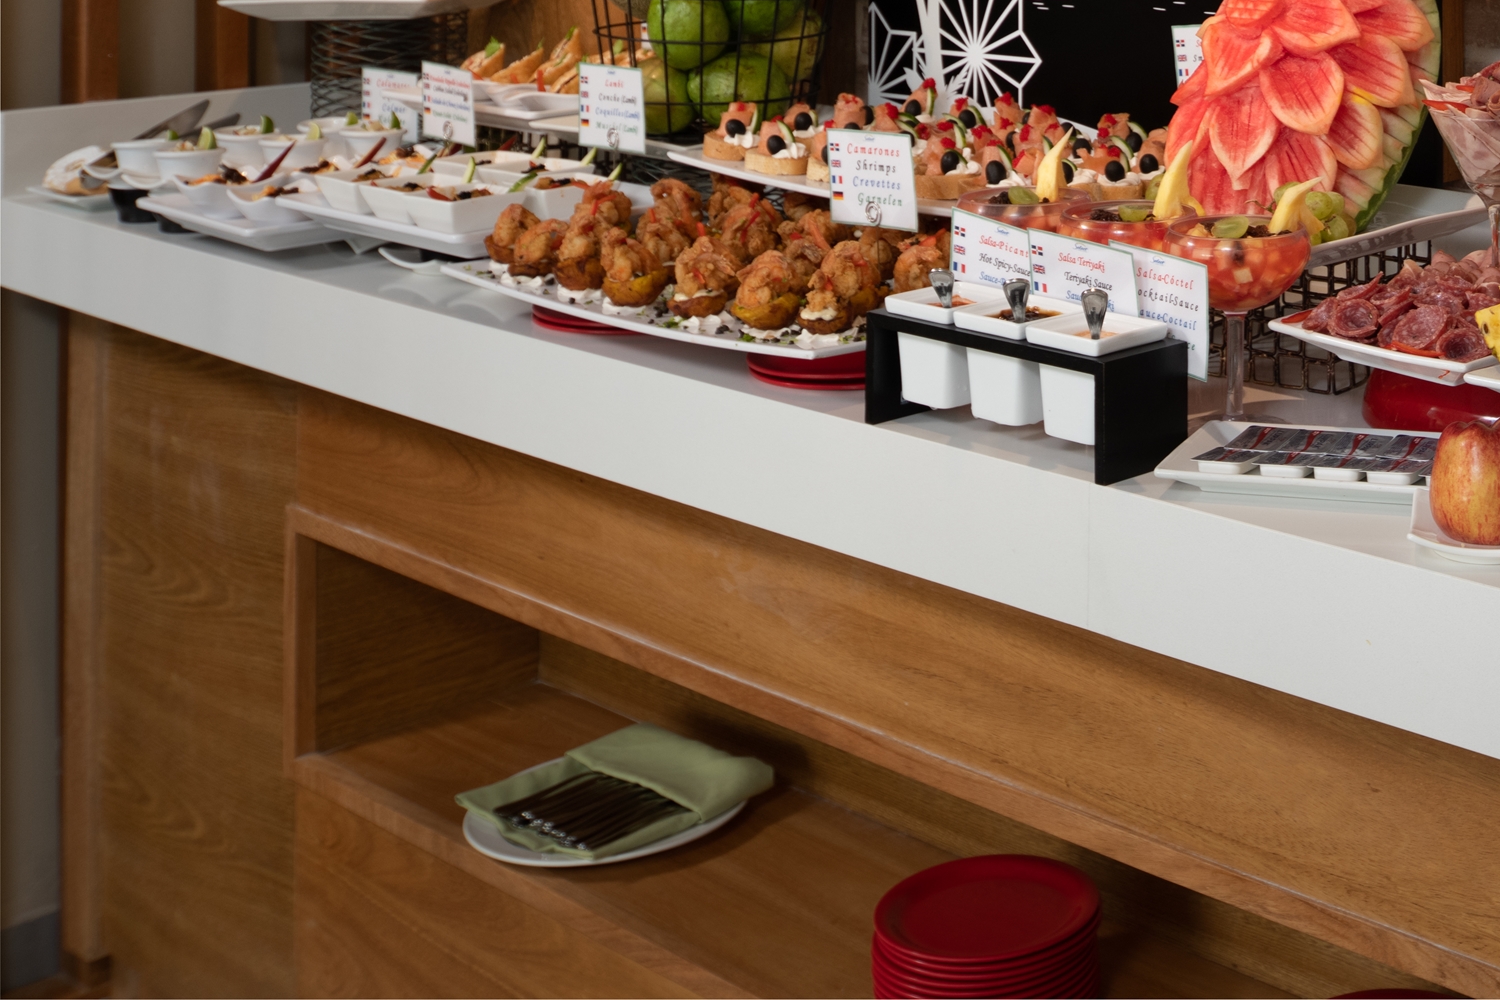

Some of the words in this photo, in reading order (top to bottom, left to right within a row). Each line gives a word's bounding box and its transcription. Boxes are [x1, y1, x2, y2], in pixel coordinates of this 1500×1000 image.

[847, 143, 900, 157] Camarones
[855, 159, 896, 176] Shrimps
[852, 176, 900, 190] Crevettes
[857, 192, 902, 206] Garnelen
[979, 235, 1029, 258] Salsa-Picant
[979, 253, 992, 264] Hot
[1058, 252, 1076, 264] Salsa
[1077, 256, 1105, 273] Teriyaki
[1064, 271, 1092, 288] Teriyaki
[1093, 278, 1112, 291] Sauce
[1138, 287, 1199, 312] ocktail-Sauce
[1140, 309, 1197, 331] auce-Coctail
